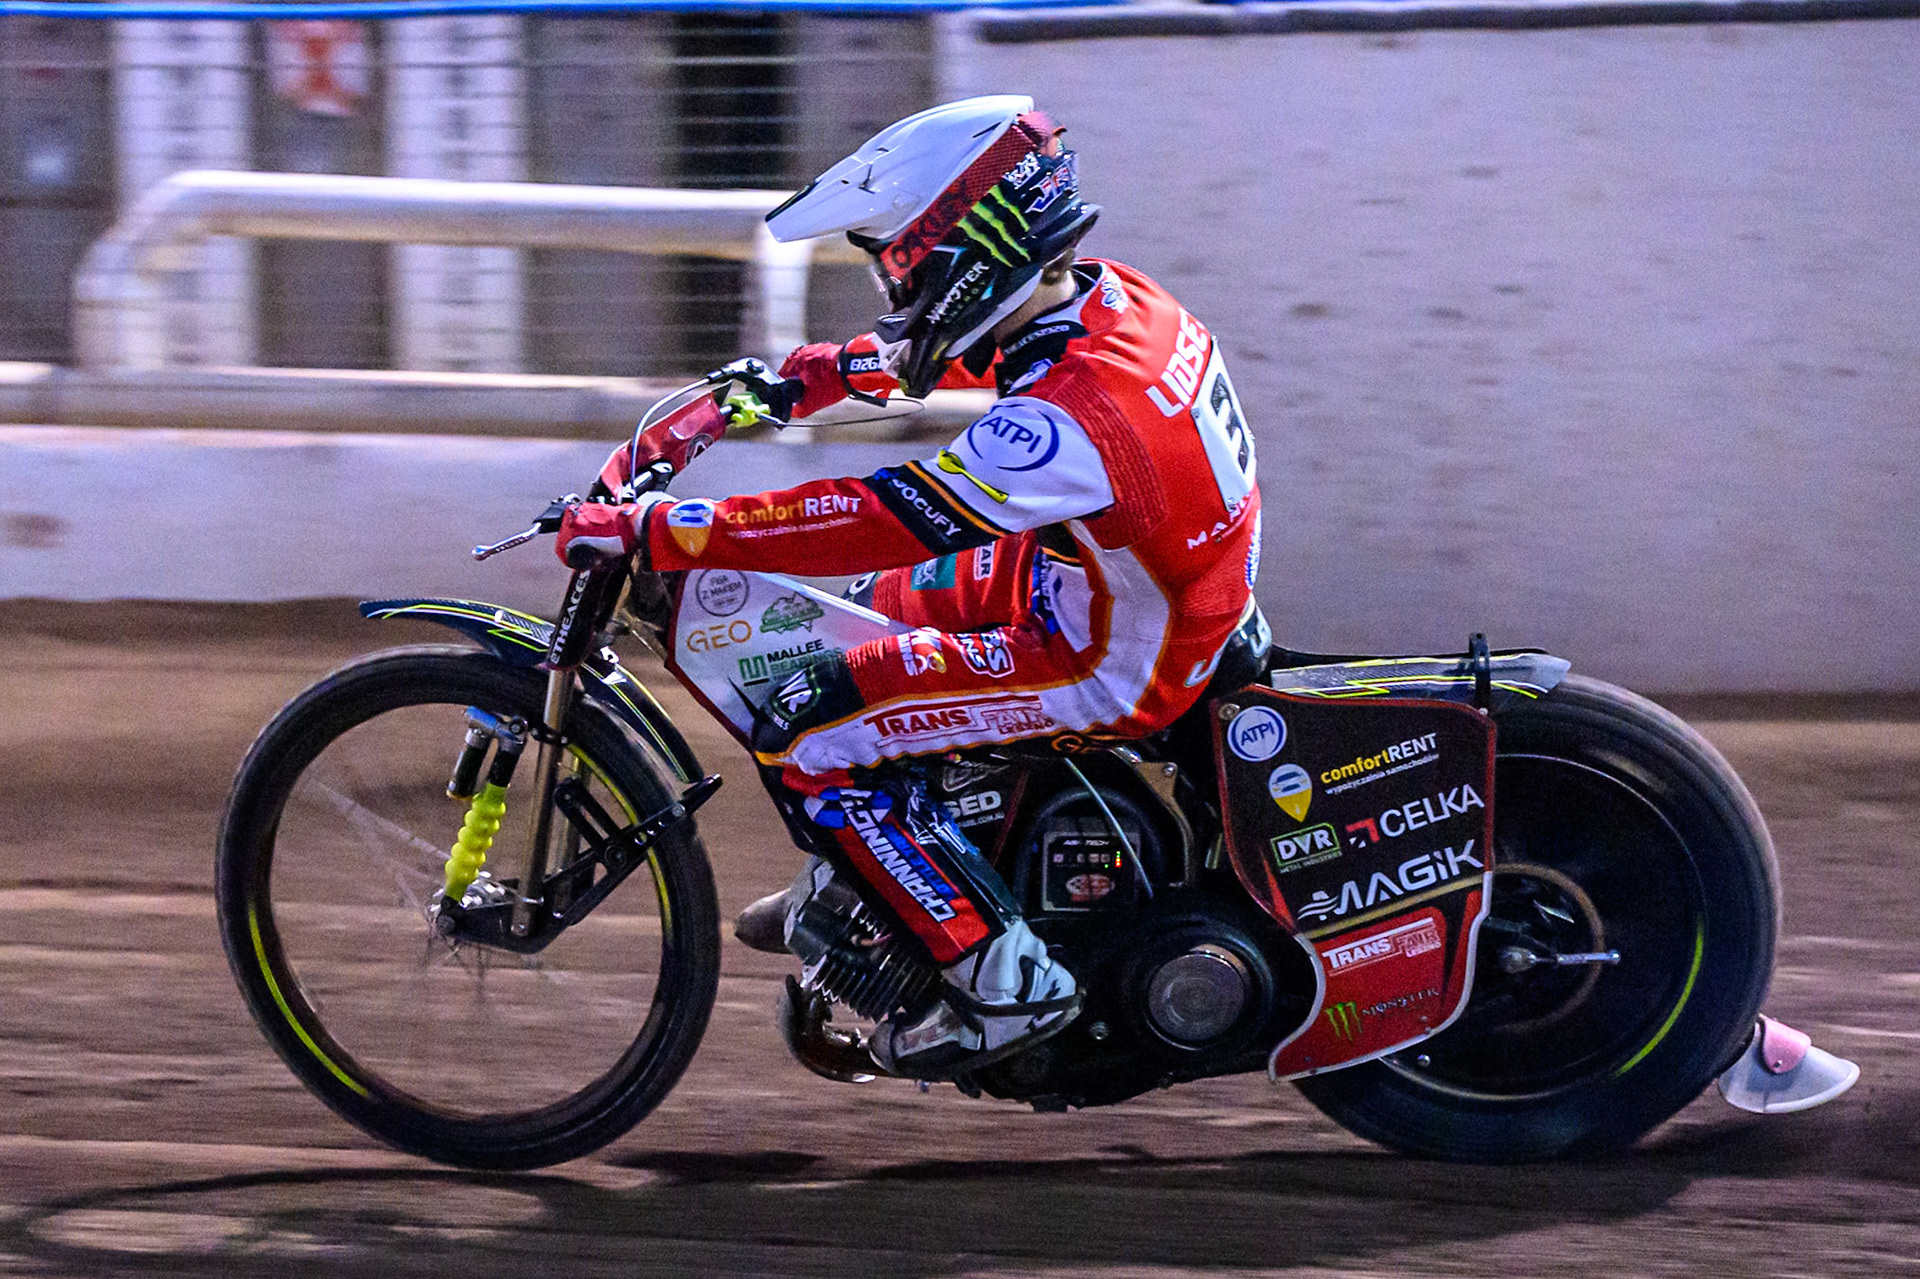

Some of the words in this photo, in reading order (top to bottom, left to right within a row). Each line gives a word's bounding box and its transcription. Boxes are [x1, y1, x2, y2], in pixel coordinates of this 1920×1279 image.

[980, 415, 1042, 454] ATPI
[725, 494, 862, 525] comfortRENT
[702, 590, 710, 600] Z
[686, 620, 752, 653] GEO
[767, 639, 825, 663] MALLEE
[864, 707, 972, 738] TRANS
[1240, 721, 1276, 746] ATPI
[1320, 732, 1437, 784] comfortRENT
[1380, 784, 1485, 838] CELKA
[1277, 829, 1334, 861] DVR
[1322, 937, 1392, 969] TRANS
[1361, 987, 1440, 1017] MONSTER
